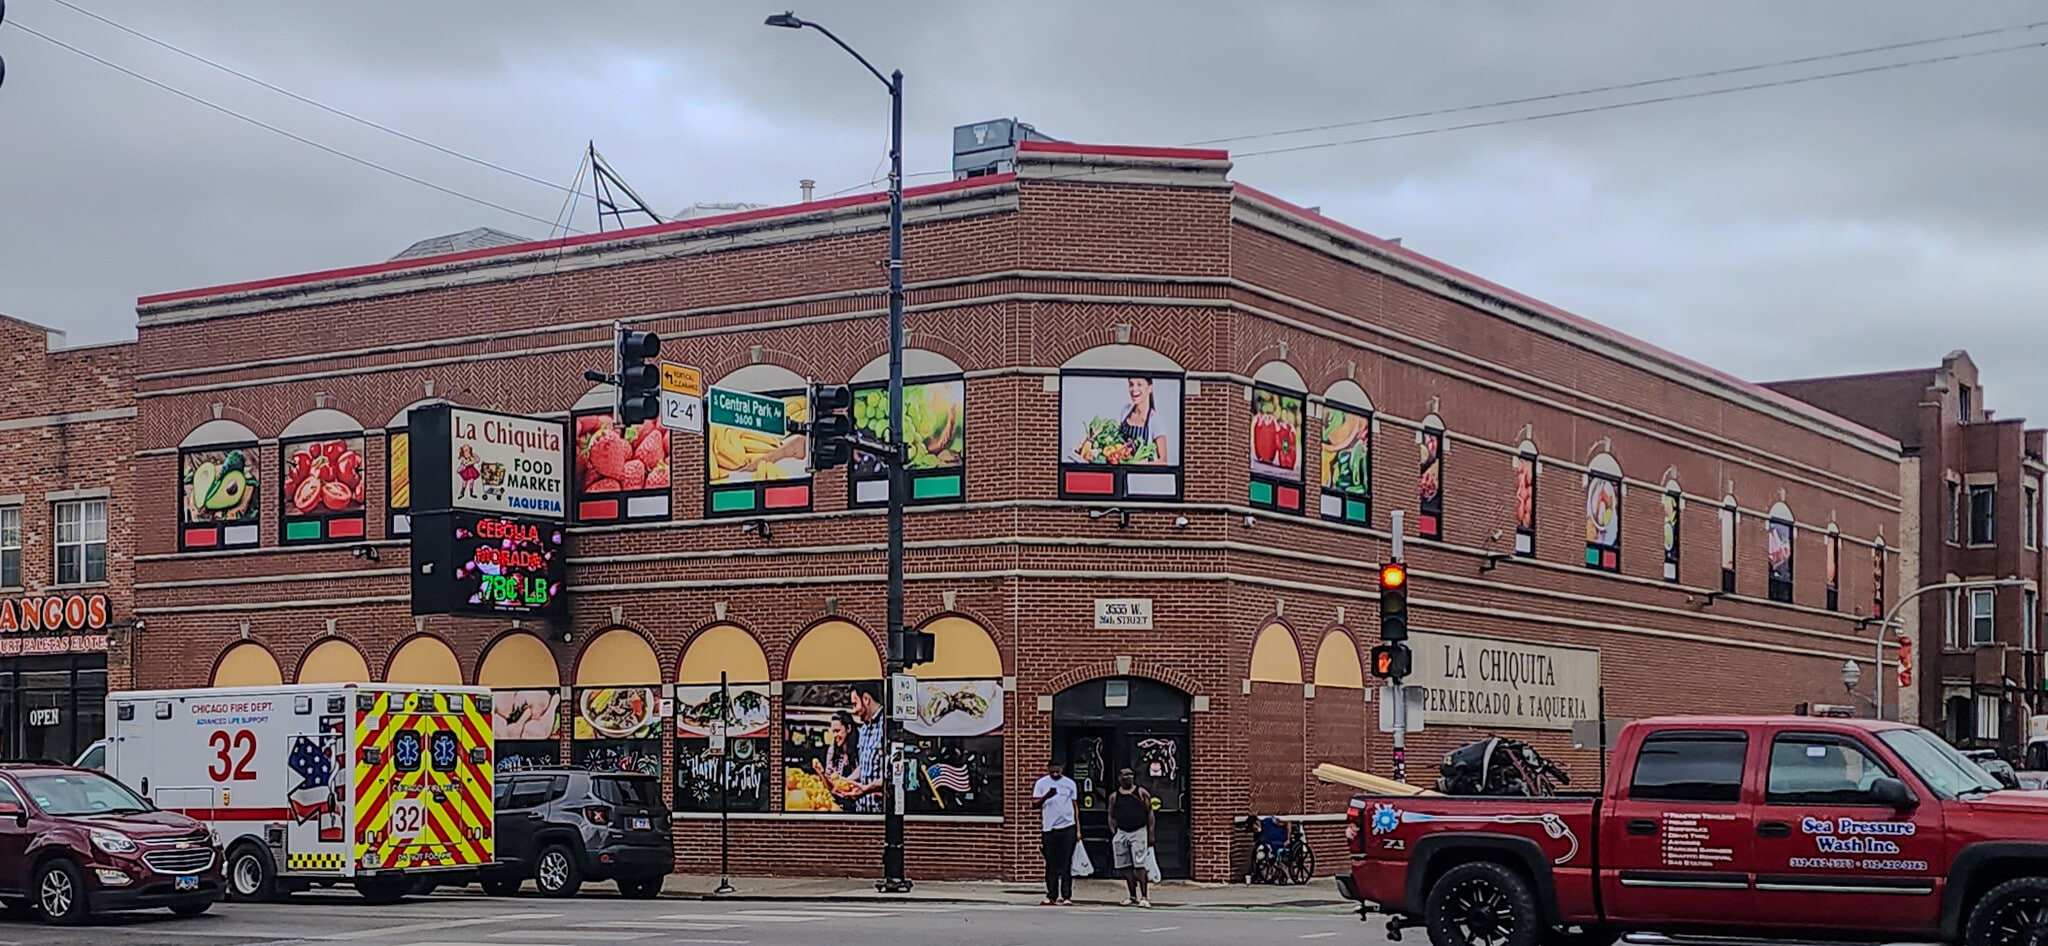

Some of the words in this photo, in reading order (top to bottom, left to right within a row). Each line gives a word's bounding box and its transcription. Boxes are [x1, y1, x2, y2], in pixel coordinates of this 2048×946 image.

[719, 393, 750, 414] Central
[752, 400, 772, 418] Park
[734, 412, 753, 426] 3600
[455, 416, 476, 441] La
[483, 420, 560, 454] Chiquita
[514, 458, 553, 475] FOOD
[507, 473, 561, 493] MARKET
[507, 495, 562, 512] TAQUERIA
[476, 518, 539, 541] CEBOLLA
[481, 574, 517, 601] 78¢
[523, 576, 547, 604] LB
[0, 594, 106, 633] ANGOS
[1105, 603, 1127, 615] 3555
[1116, 615, 1148, 625] STREET
[0, 637, 21, 654] URT
[23, 635, 69, 653] PALETAS
[1444, 645, 1466, 679] LA
[1479, 648, 1555, 690] CHIQUITA
[191, 704, 228, 714] CHICAGO
[230, 703, 249, 713] FIRE
[250, 702, 274, 713] DEPT.
[1422, 687, 1510, 716] PERMERCADO
[1516, 694, 1523, 716] &
[1529, 695, 1587, 722] TAQUERIA
[29, 708, 60, 726] OPEN
[208, 729, 257, 783] 32
[395, 806, 420, 833] 32
[1803, 817, 1833, 834] Sea
[1838, 818, 1915, 835] Pressure
[1817, 836, 1863, 852] Wash
[1866, 837, 1899, 853] Inc.
